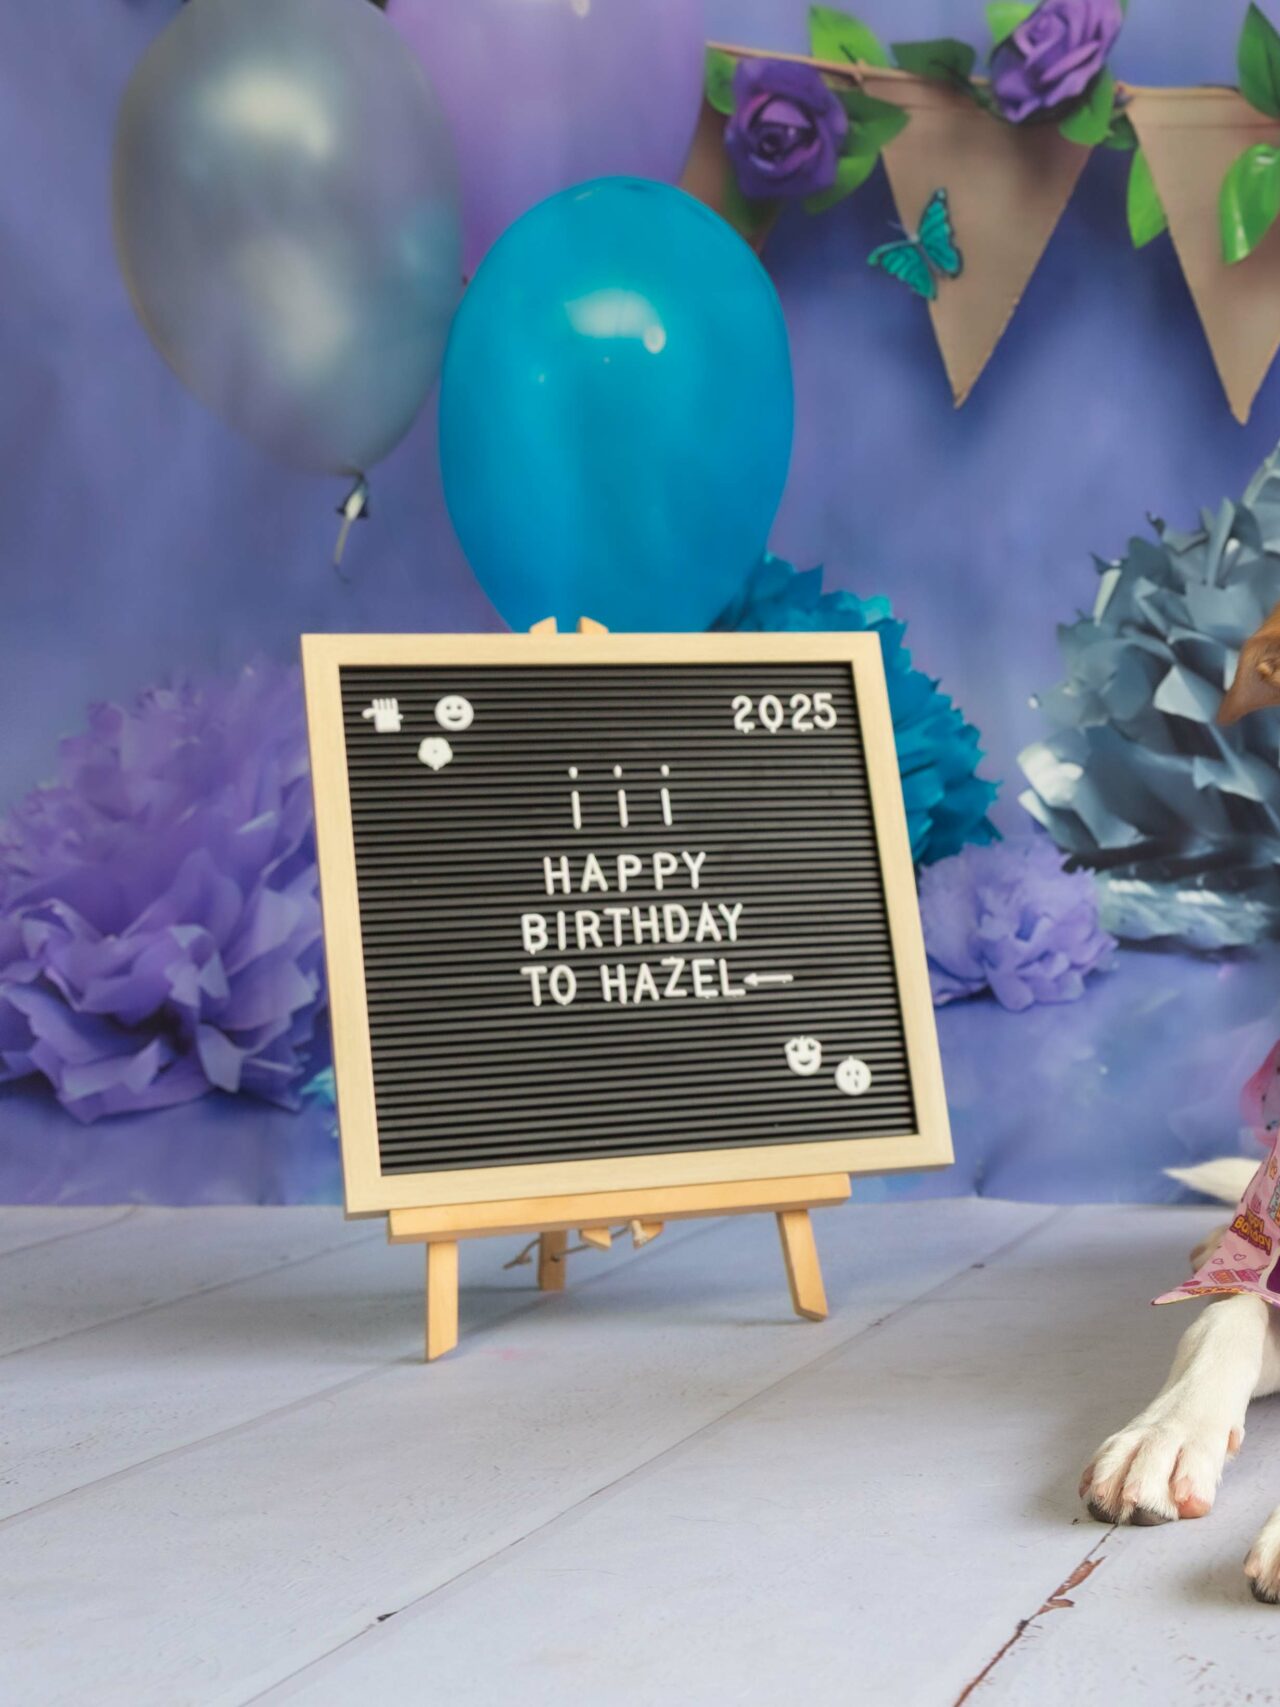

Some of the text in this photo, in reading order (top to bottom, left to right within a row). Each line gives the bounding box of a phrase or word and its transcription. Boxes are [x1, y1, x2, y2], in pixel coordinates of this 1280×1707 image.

[731, 691, 838, 734] 2025
[543, 850, 707, 896] HAPPY
[521, 901, 743, 955] BIRTHDAY
[520, 955, 746, 1007] TO HAZEL
